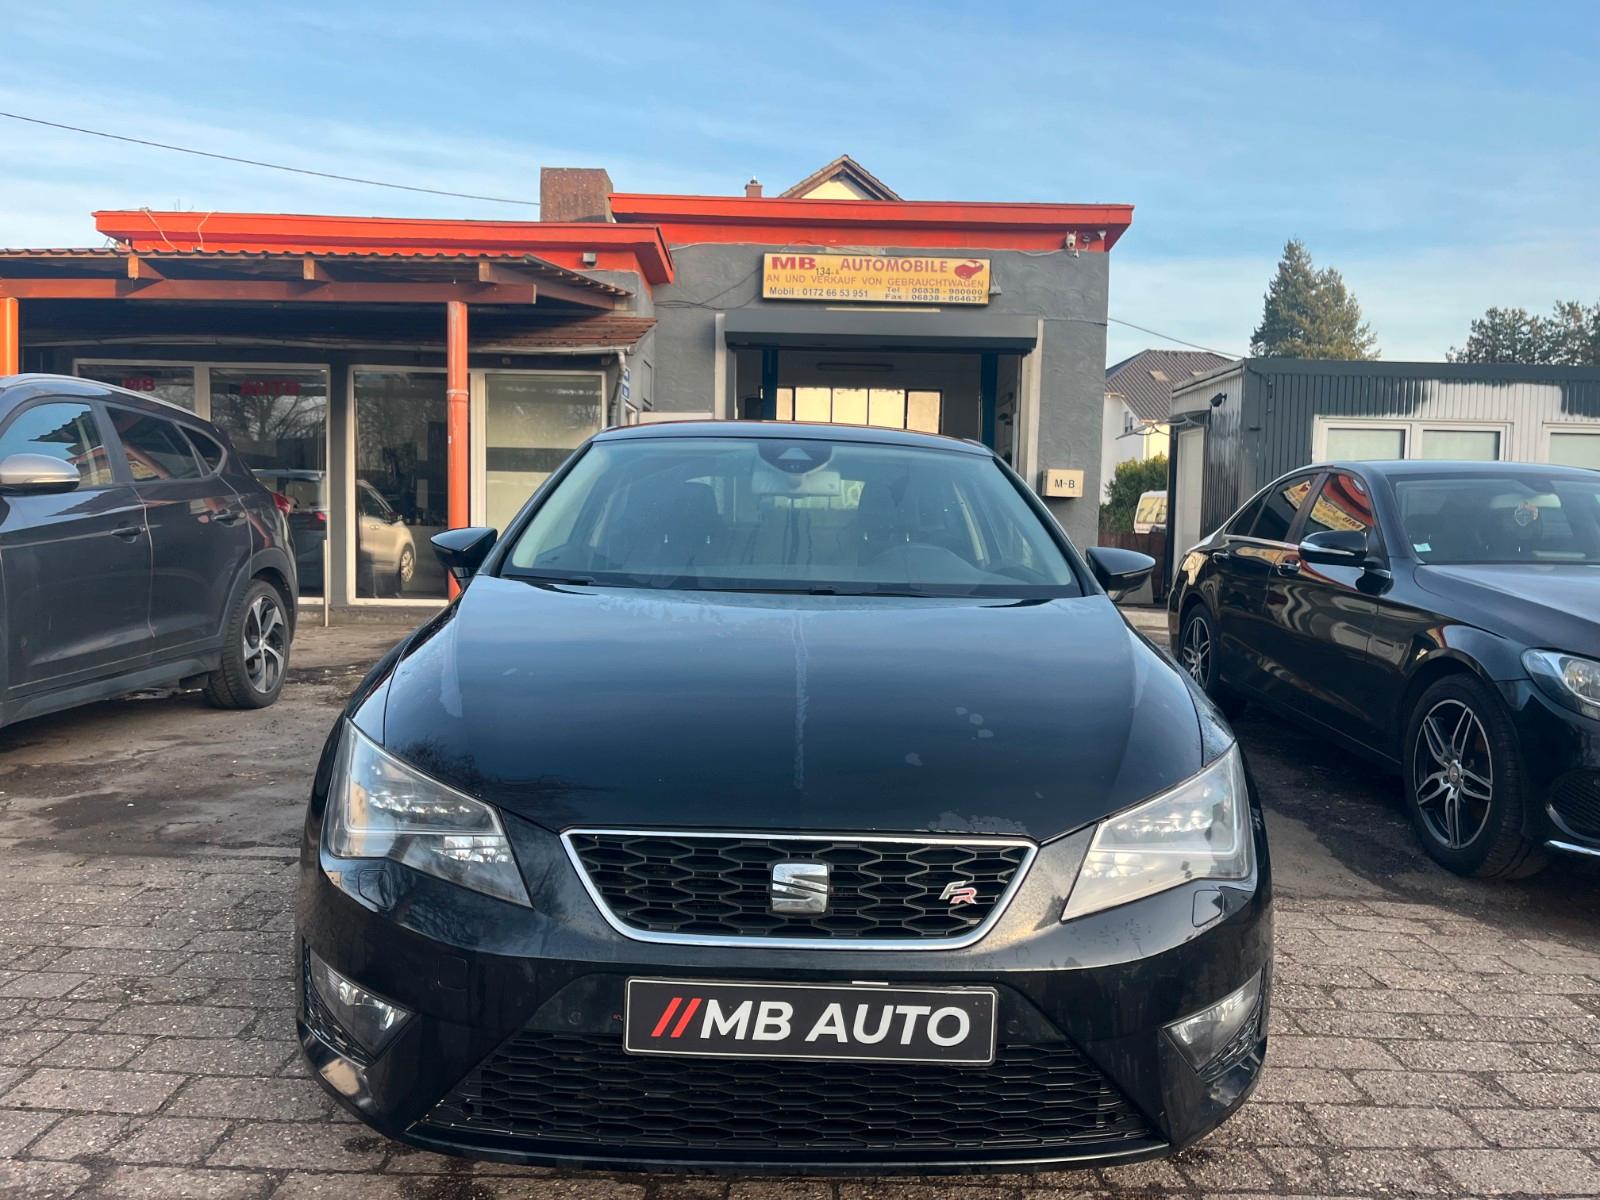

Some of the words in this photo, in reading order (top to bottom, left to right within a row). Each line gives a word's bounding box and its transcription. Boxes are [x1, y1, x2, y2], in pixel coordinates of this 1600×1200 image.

[771, 256, 817, 270] MB
[840, 258, 949, 273] AUTOMOBILE
[766, 274, 780, 282] AN
[785, 275, 806, 283] UND
[811, 276, 856, 284] VERKAUF
[862, 277, 882, 285] VON
[887, 278, 984, 288] GEBRAUCHTWAGEN
[769, 287, 794, 295] Mobil
[802, 288, 824, 297] 0172
[826, 288, 837, 297] 66
[840, 289, 850, 297] 53
[852, 289, 868, 298] 951
[938, 880, 977, 905] FR
[805, 1002, 971, 1047] AUTO
